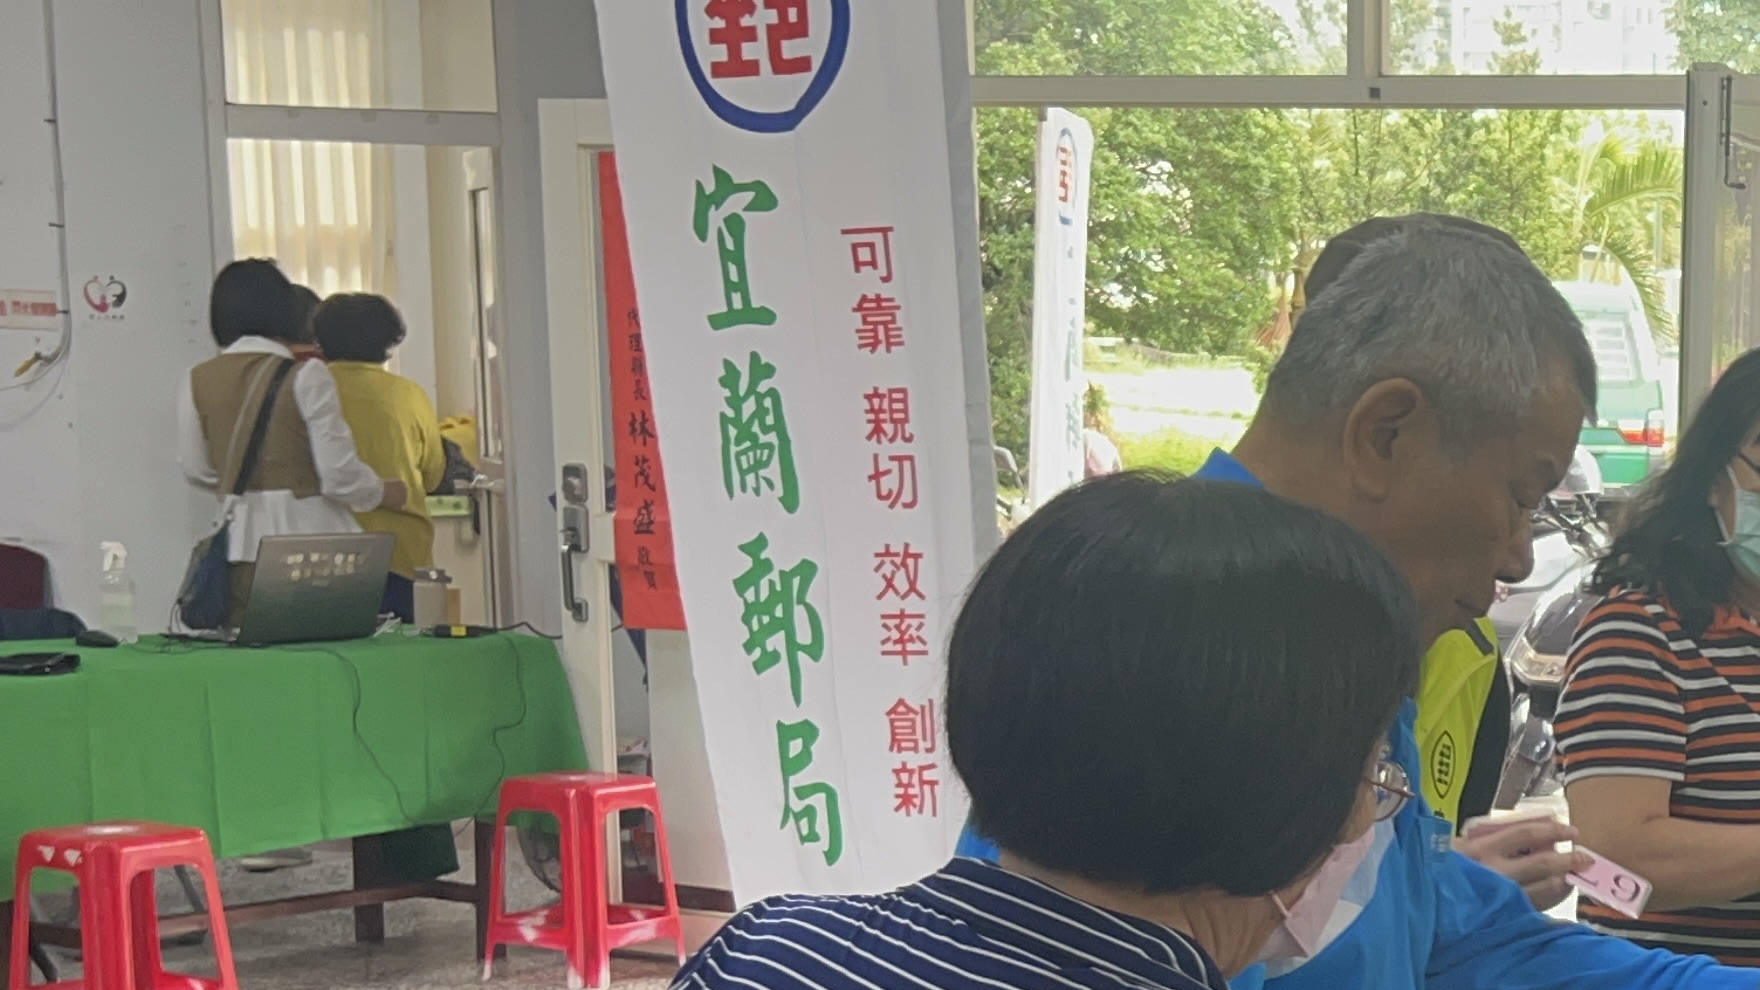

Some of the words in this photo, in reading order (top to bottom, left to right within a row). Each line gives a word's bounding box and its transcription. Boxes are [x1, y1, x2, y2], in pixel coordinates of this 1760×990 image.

[840, 226, 906, 355] 可靠
[628, 410, 656, 535] 林茂盛
[864, 386, 920, 511] 親切
[693, 164, 843, 866] 宜蘭郵局
[874, 542, 929, 666] 效率
[885, 697, 939, 818] 創新
